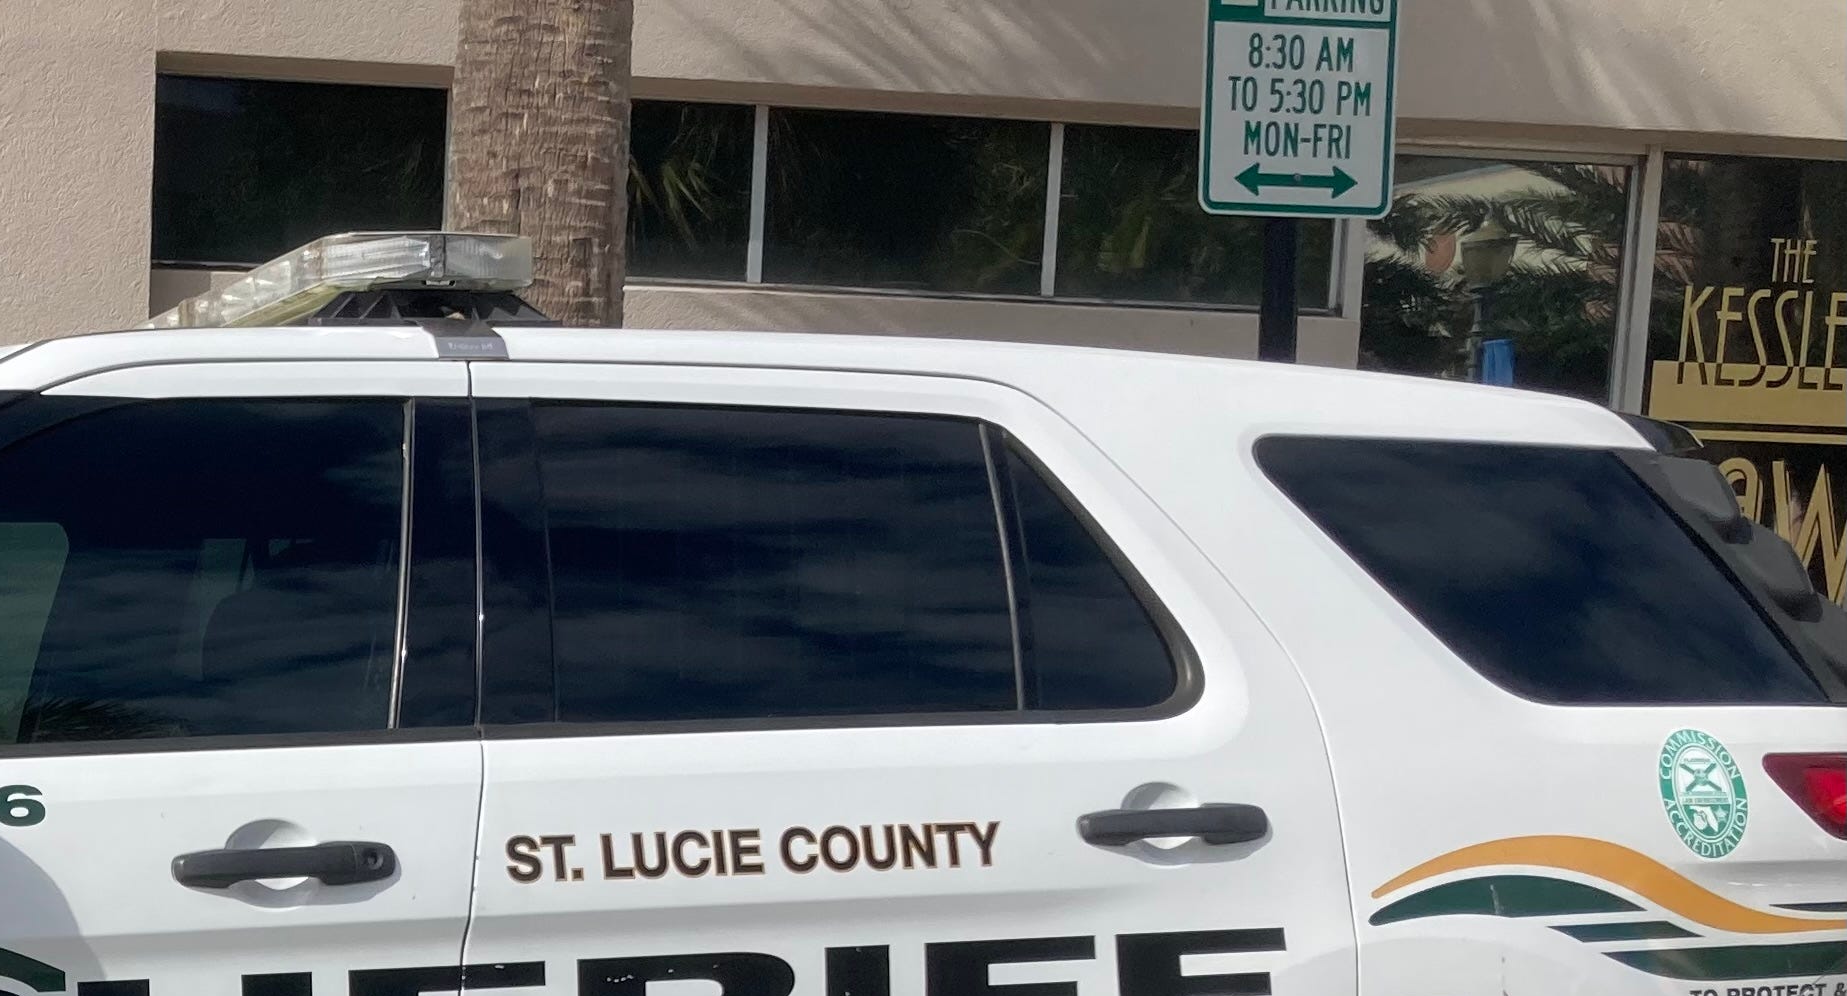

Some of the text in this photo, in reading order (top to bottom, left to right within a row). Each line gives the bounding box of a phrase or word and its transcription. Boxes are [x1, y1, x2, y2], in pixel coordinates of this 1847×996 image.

[1248, 33, 1354, 72] 8:30 AM
[1228, 76, 1372, 117] TO 5:30 PM
[1243, 120, 1352, 159] MON-FRI
[1770, 238, 1818, 284] THE
[1659, 730, 1741, 780] COMMISSION
[1665, 797, 1748, 858] ACCREDITATION
[505, 820, 1001, 884] ST. LUCIE COUNTY
